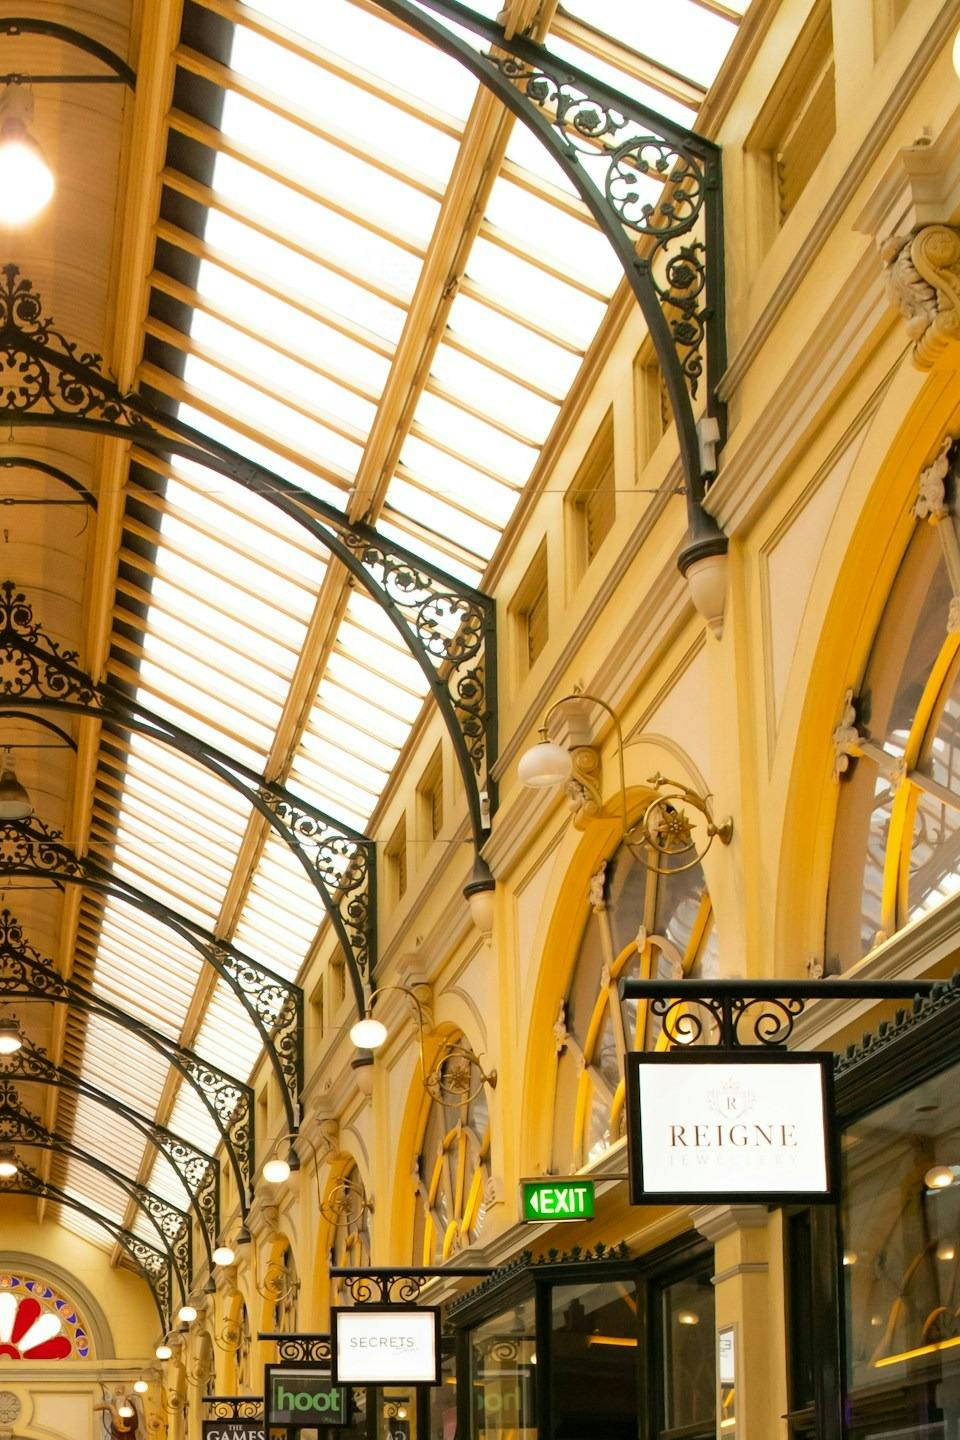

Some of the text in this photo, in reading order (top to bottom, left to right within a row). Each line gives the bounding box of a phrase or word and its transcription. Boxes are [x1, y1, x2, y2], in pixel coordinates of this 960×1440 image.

[727, 1097, 736, 1110] R
[670, 1125, 798, 1147] REIGNE
[540, 1188, 587, 1213] EXIT
[350, 1337, 415, 1348] SECRETS
[278, 1386, 340, 1412] hoot
